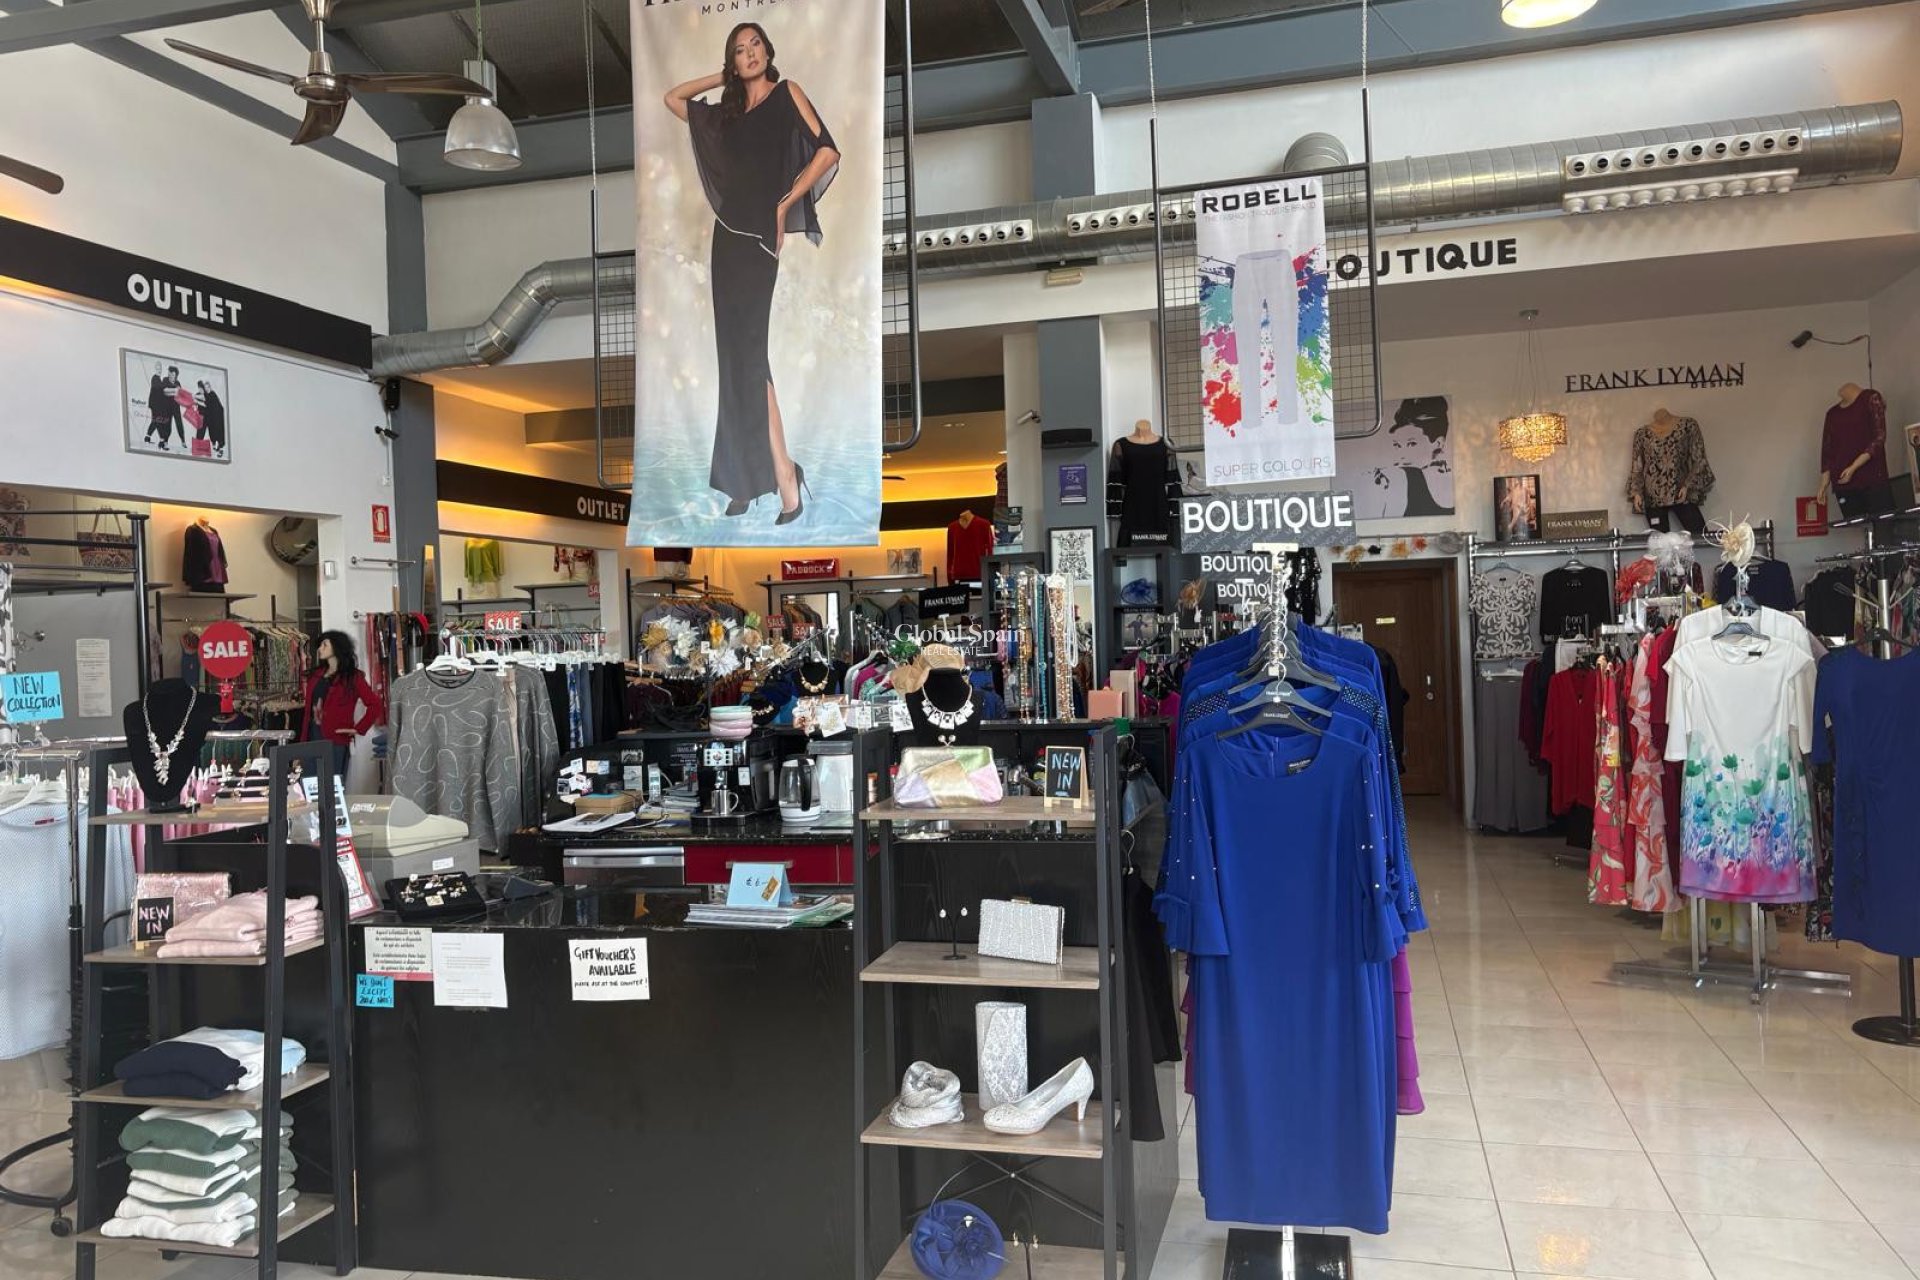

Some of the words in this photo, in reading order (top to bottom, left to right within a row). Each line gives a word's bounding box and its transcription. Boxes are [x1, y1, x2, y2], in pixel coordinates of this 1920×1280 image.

[1202, 185, 1317, 213] ROBELL
[1326, 238, 1517, 281] OUTIQUE
[127, 273, 242, 327] OUTLET
[1565, 370, 1649, 394] FRANK
[1657, 362, 1746, 386] LYMAN
[1690, 380, 1744, 389] DESIGN
[1213, 462, 1260, 478] SUPER
[1263, 456, 1332, 473] COLOURS
[577, 496, 626, 522] OUTLET
[1182, 495, 1353, 534] BOUTIQUE
[1547, 520, 1573, 529] FRANK
[924, 597, 944, 608] FRANK
[487, 616, 521, 631] SALE
[203, 641, 248, 659] SALE
[13, 676, 44, 695] NEW
[7, 694, 61, 713] COLLECTION
[1052, 752, 1081, 771] NEW
[1057, 770, 1074, 790] IN
[139, 905, 170, 920] NEW
[146, 919, 162, 934] IN
[574, 946, 594, 961] GIFT
[588, 963, 637, 976] AVAILABLE
